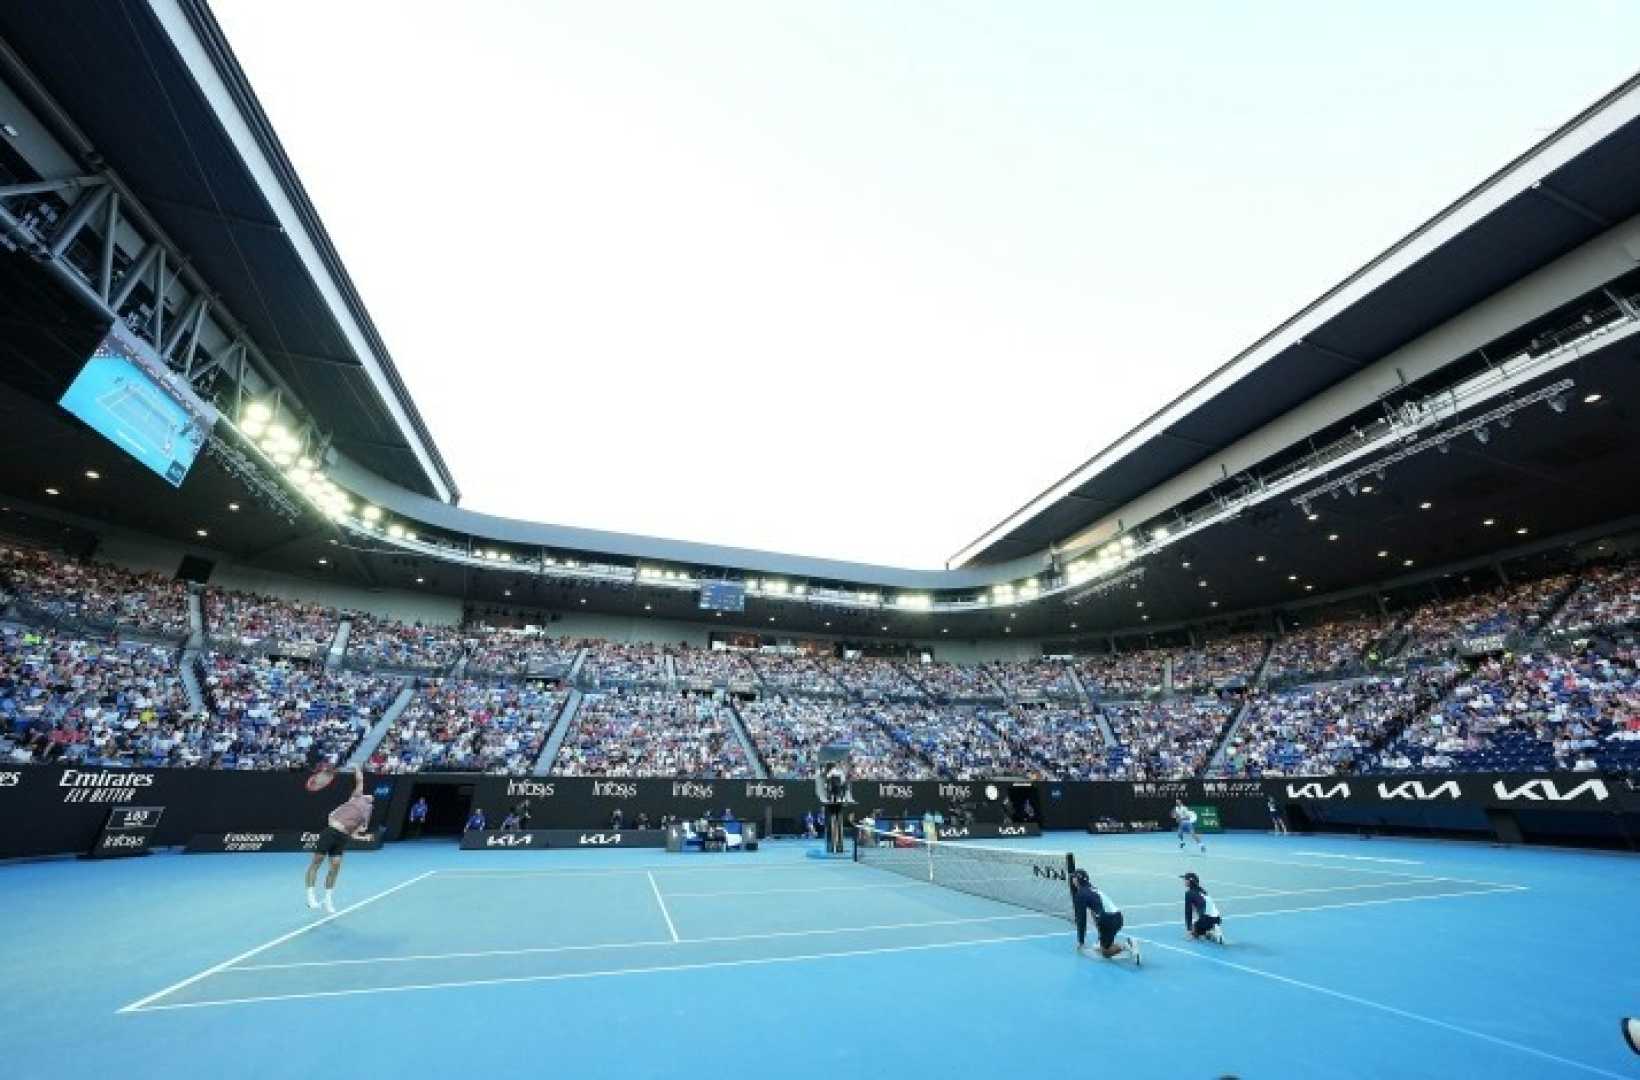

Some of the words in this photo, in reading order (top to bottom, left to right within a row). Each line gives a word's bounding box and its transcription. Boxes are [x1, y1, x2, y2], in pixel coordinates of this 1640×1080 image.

[59, 769, 154, 787] Emirates
[90, 788, 136, 802] BETTER
[507, 778, 555, 797] Infosys
[592, 780, 637, 798] Infosys
[672, 781, 713, 799] Infosys
[745, 781, 785, 799] Infosys
[879, 783, 913, 798] Infosys
